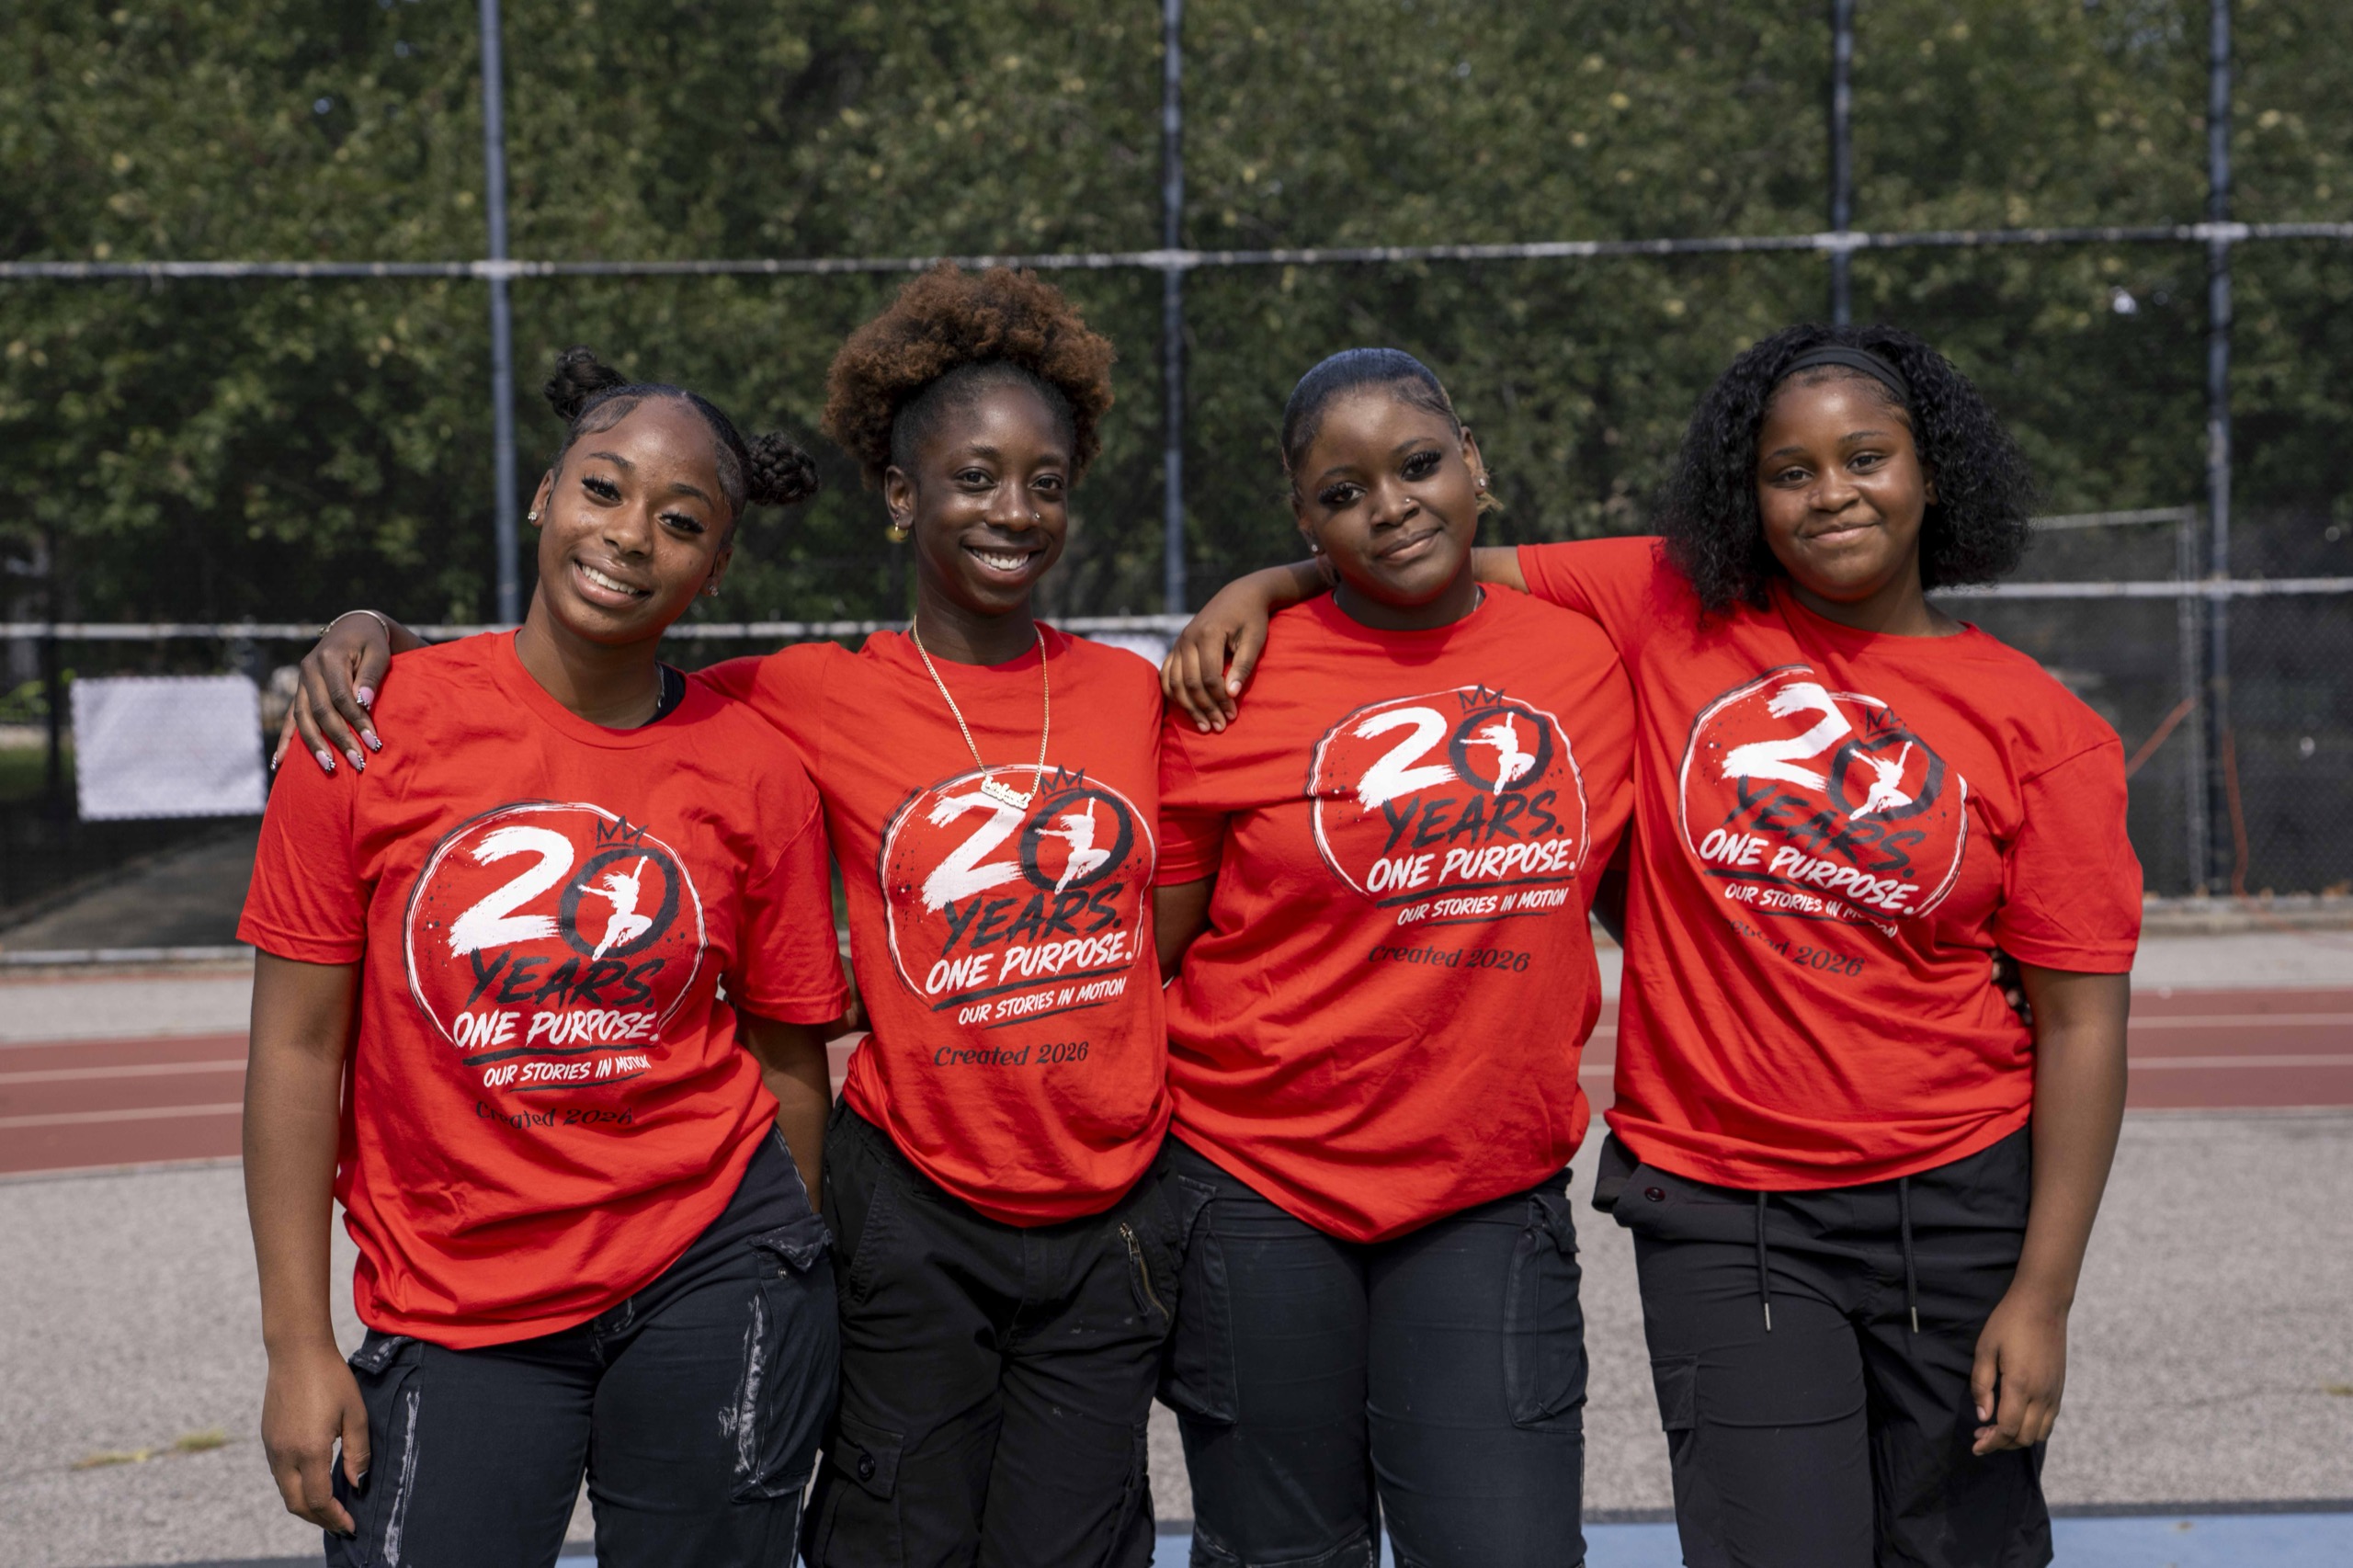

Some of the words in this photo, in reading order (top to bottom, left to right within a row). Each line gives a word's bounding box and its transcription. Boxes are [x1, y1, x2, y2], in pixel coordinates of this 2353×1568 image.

[1352, 706, 1553, 813] 20
[1381, 790, 1564, 855] YEARS.
[1722, 774, 1927, 878] YEARS.
[1367, 853, 1436, 892] ONE
[1438, 838, 1575, 886] PURPOSE.
[1699, 828, 1769, 865] ONE
[1767, 846, 1919, 915] PURPOSE.
[449, 825, 680, 960] 20
[941, 882, 1124, 957] YEARS.
[1397, 904, 1429, 926] OUR
[1431, 895, 1496, 917] STORIES
[1500, 892, 1516, 912] IN
[1517, 888, 1569, 909] MOTION
[1724, 882, 1758, 903] OUR
[1759, 889, 1822, 913] STORIES
[1825, 900, 1843, 918] IN
[464, 948, 665, 1009] YEARS.
[926, 953, 993, 994] ONE
[998, 930, 1132, 985] PURPOSE.
[1467, 944, 1531, 972] 2026
[1793, 945, 1865, 977] 2026
[959, 1003, 991, 1026] OUR
[995, 991, 1053, 1018] STORIES
[1058, 986, 1074, 1007] IN
[1076, 977, 1127, 1003] MOTION
[453, 1008, 520, 1050] ONE
[526, 1009, 660, 1046] PURPOSE.
[934, 1044, 1030, 1066] Created
[1035, 1041, 1089, 1064] 2026
[483, 1063, 518, 1087] OUR
[520, 1062, 591, 1082] STORIES
[596, 1058, 612, 1078] IN
